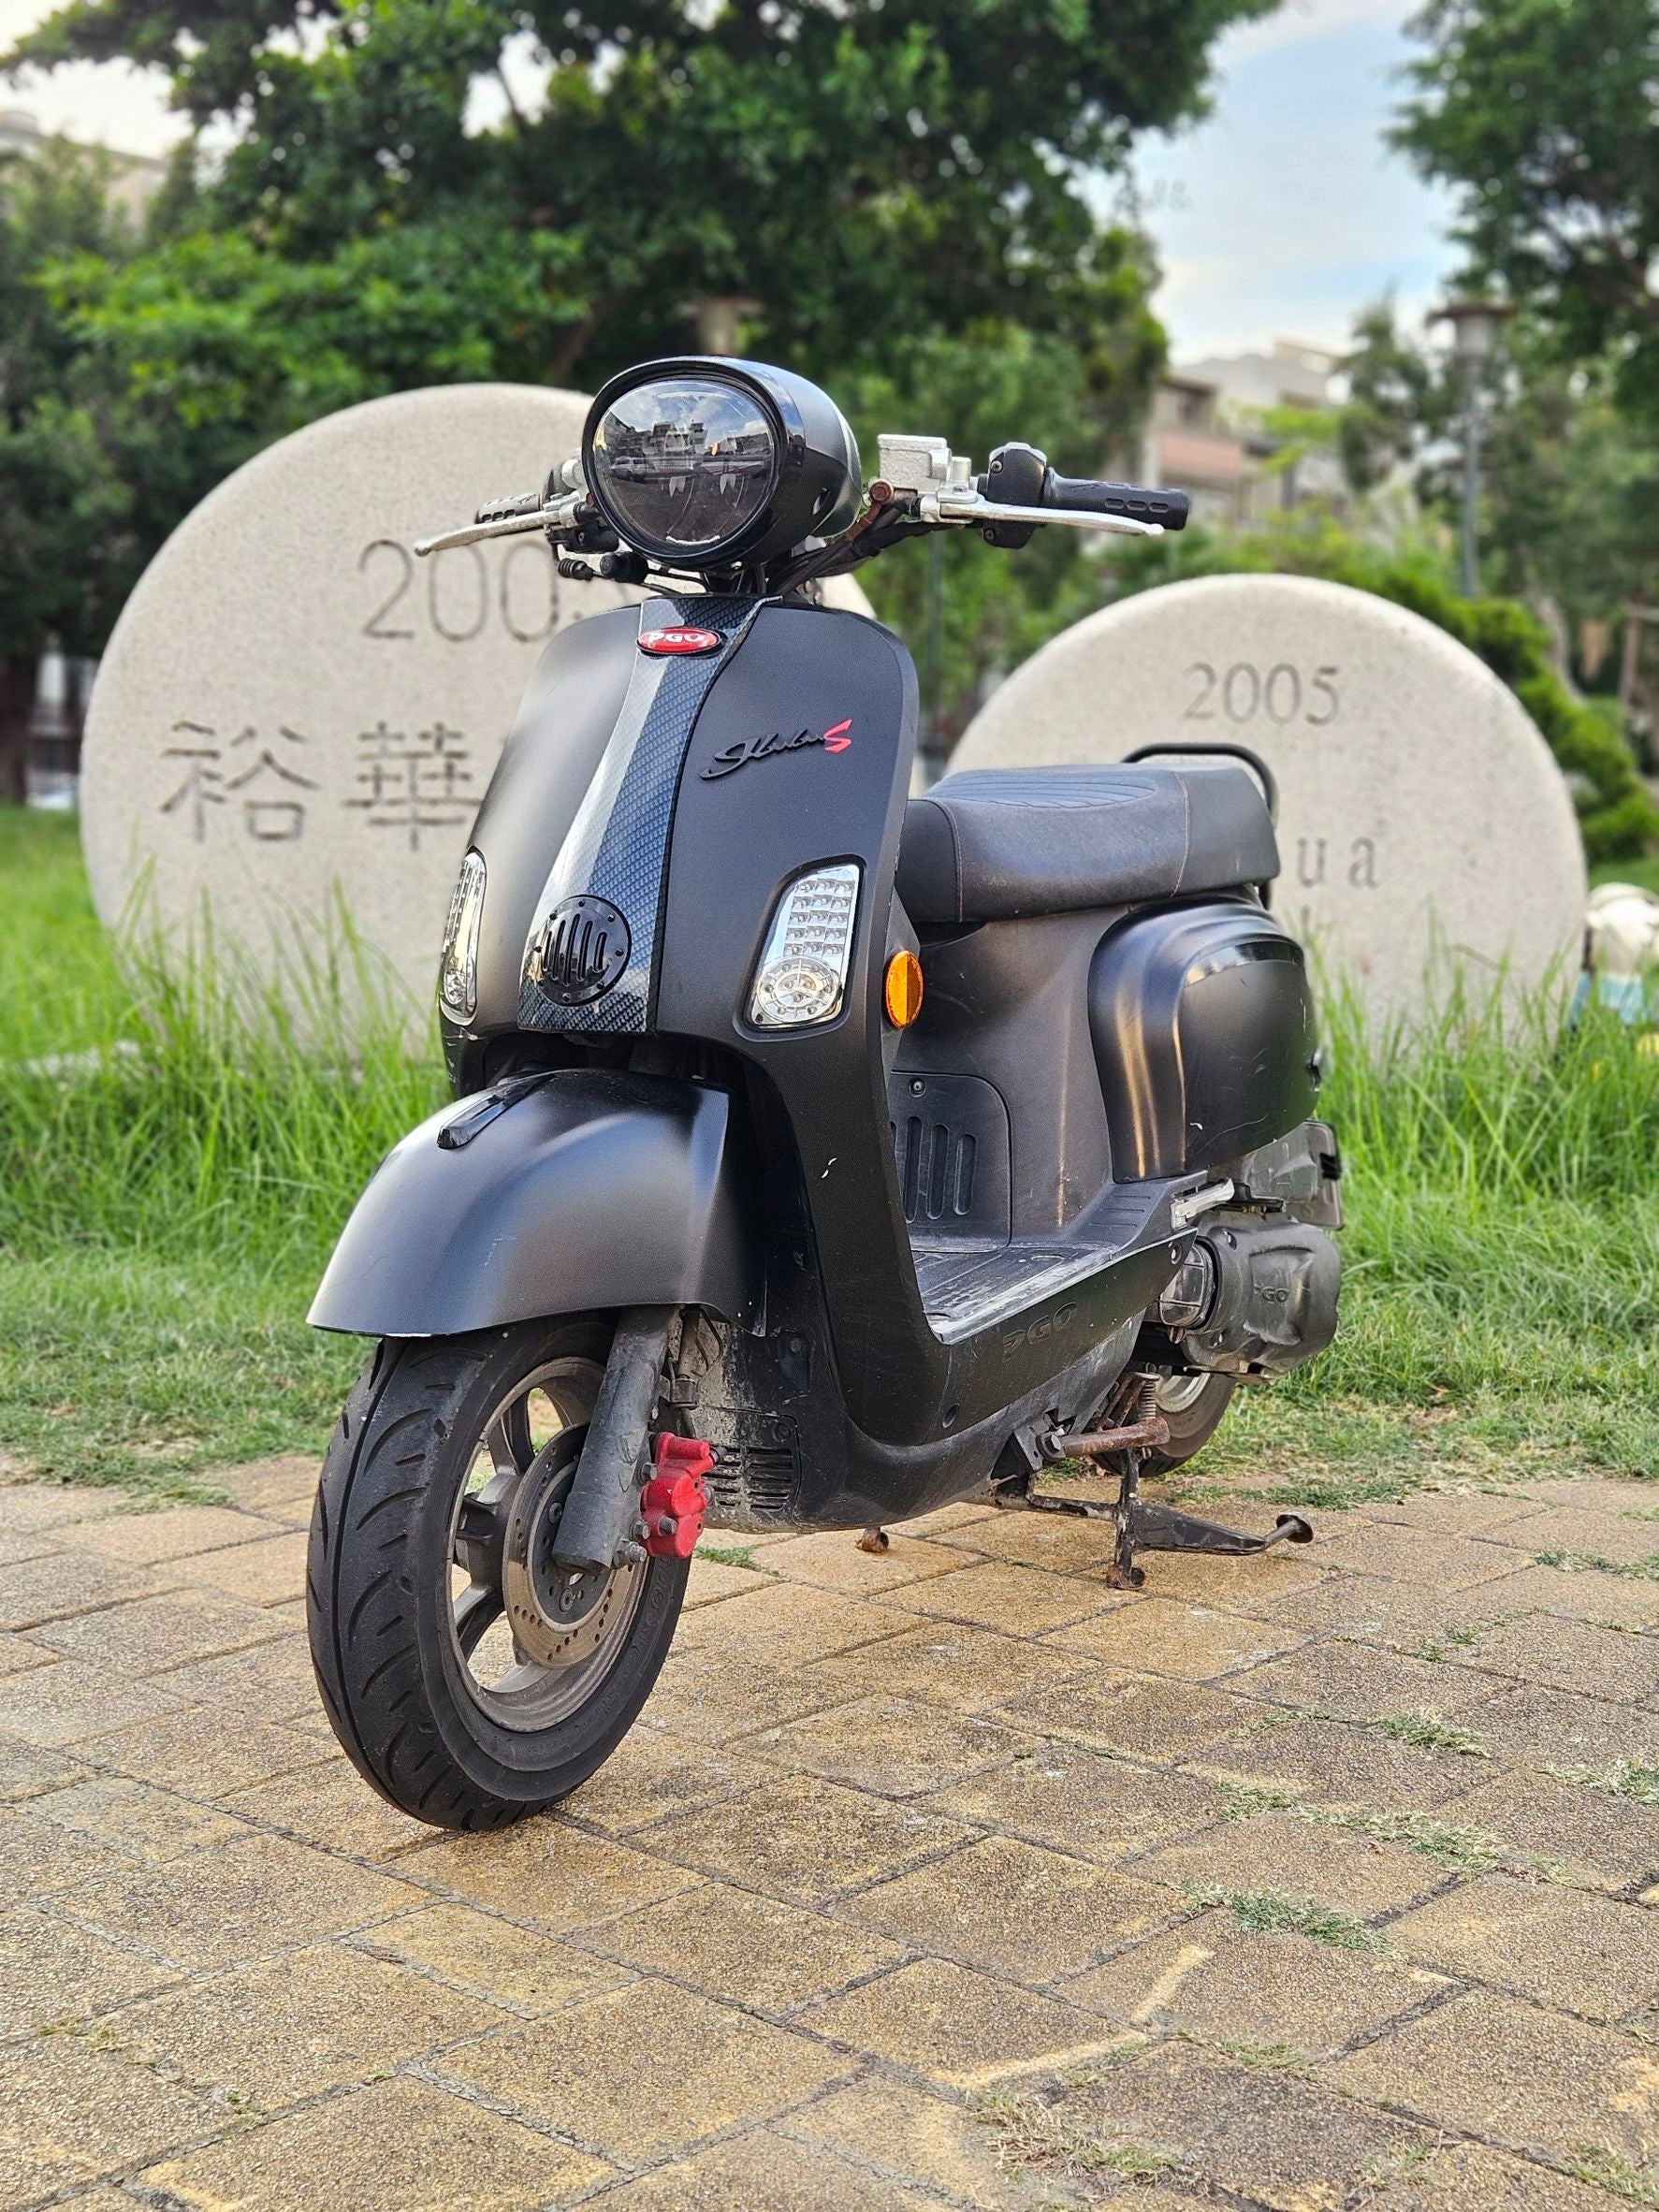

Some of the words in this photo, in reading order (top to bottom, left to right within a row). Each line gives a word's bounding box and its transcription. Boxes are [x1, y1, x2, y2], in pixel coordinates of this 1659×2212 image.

[357, 538, 629, 643] 200
[648, 632, 704, 644] PGO
[1184, 662, 1340, 727] 2005
[160, 719, 507, 851] 裕華
[1003, 1302, 1078, 1363] PGO
